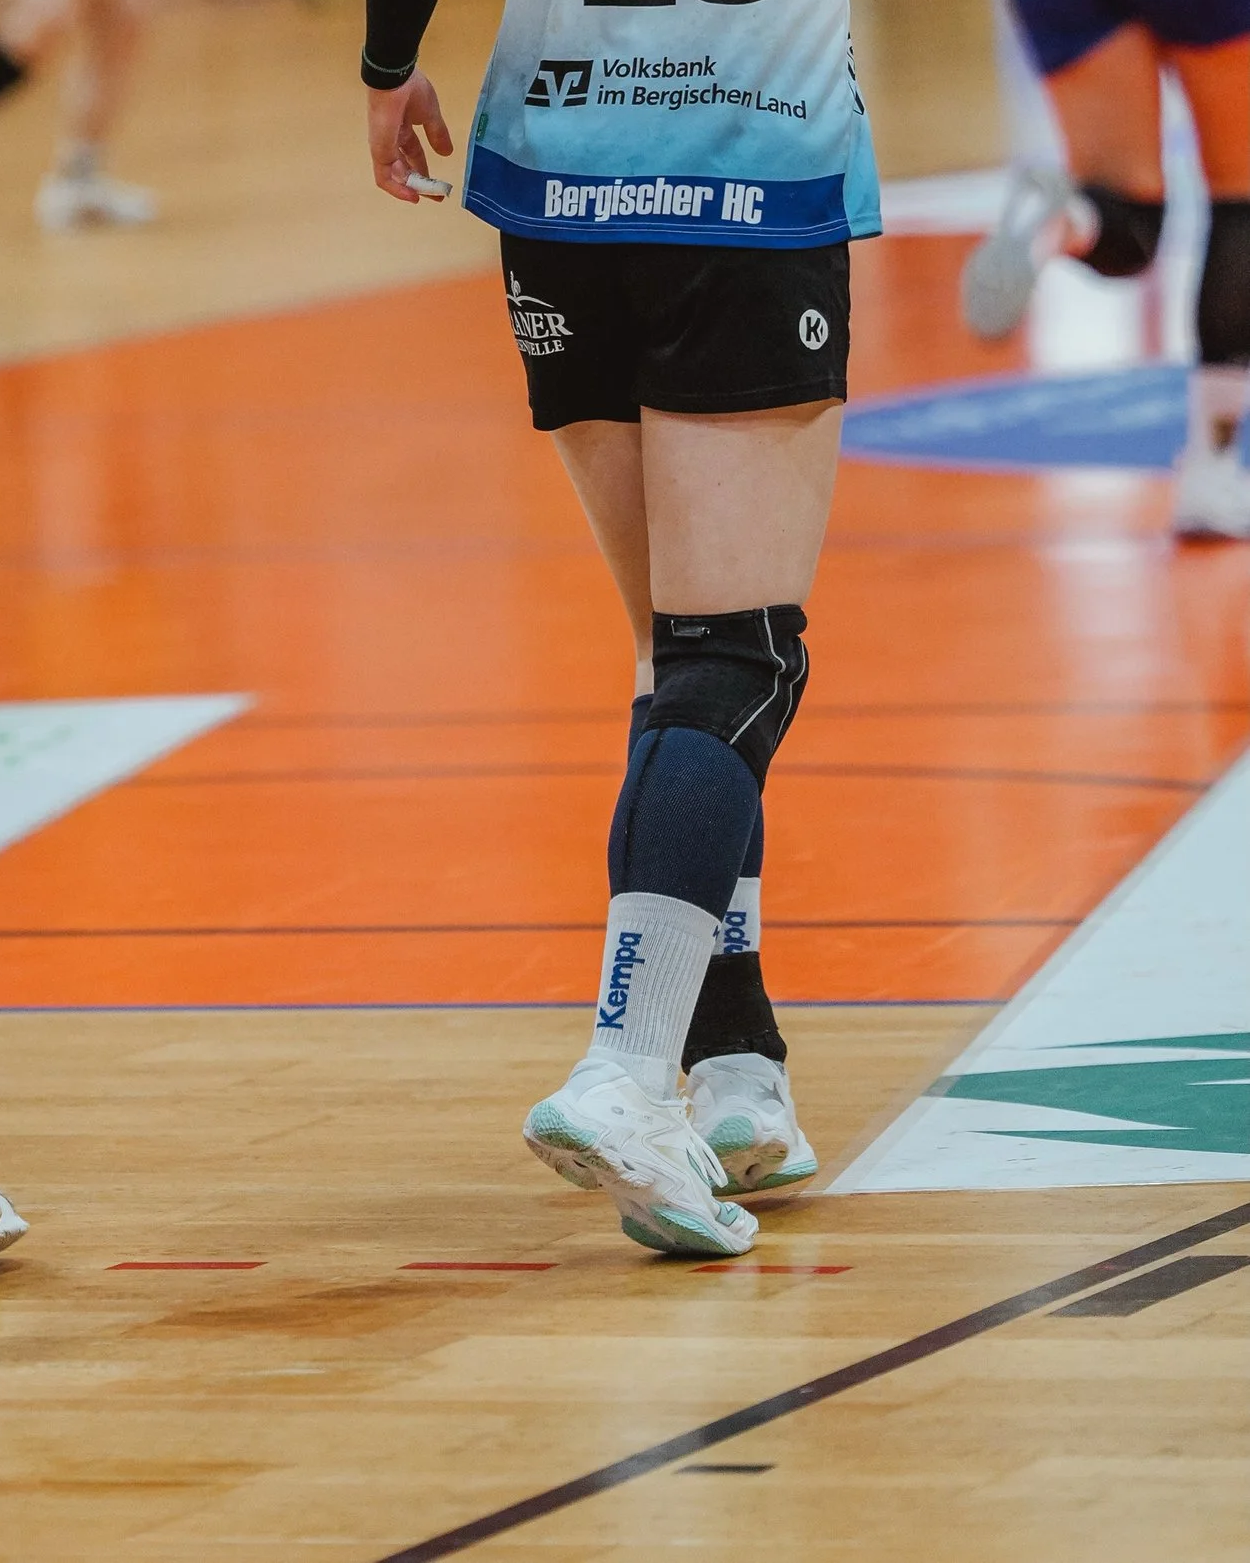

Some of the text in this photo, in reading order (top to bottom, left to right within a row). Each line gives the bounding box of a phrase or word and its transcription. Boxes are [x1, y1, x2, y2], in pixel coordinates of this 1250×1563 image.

[602, 55, 717, 79] Volksbank
[596, 83, 808, 120] im Bergischen Land
[544, 177, 765, 226] Bergischer HC
[596, 931, 646, 1031] Kempa
